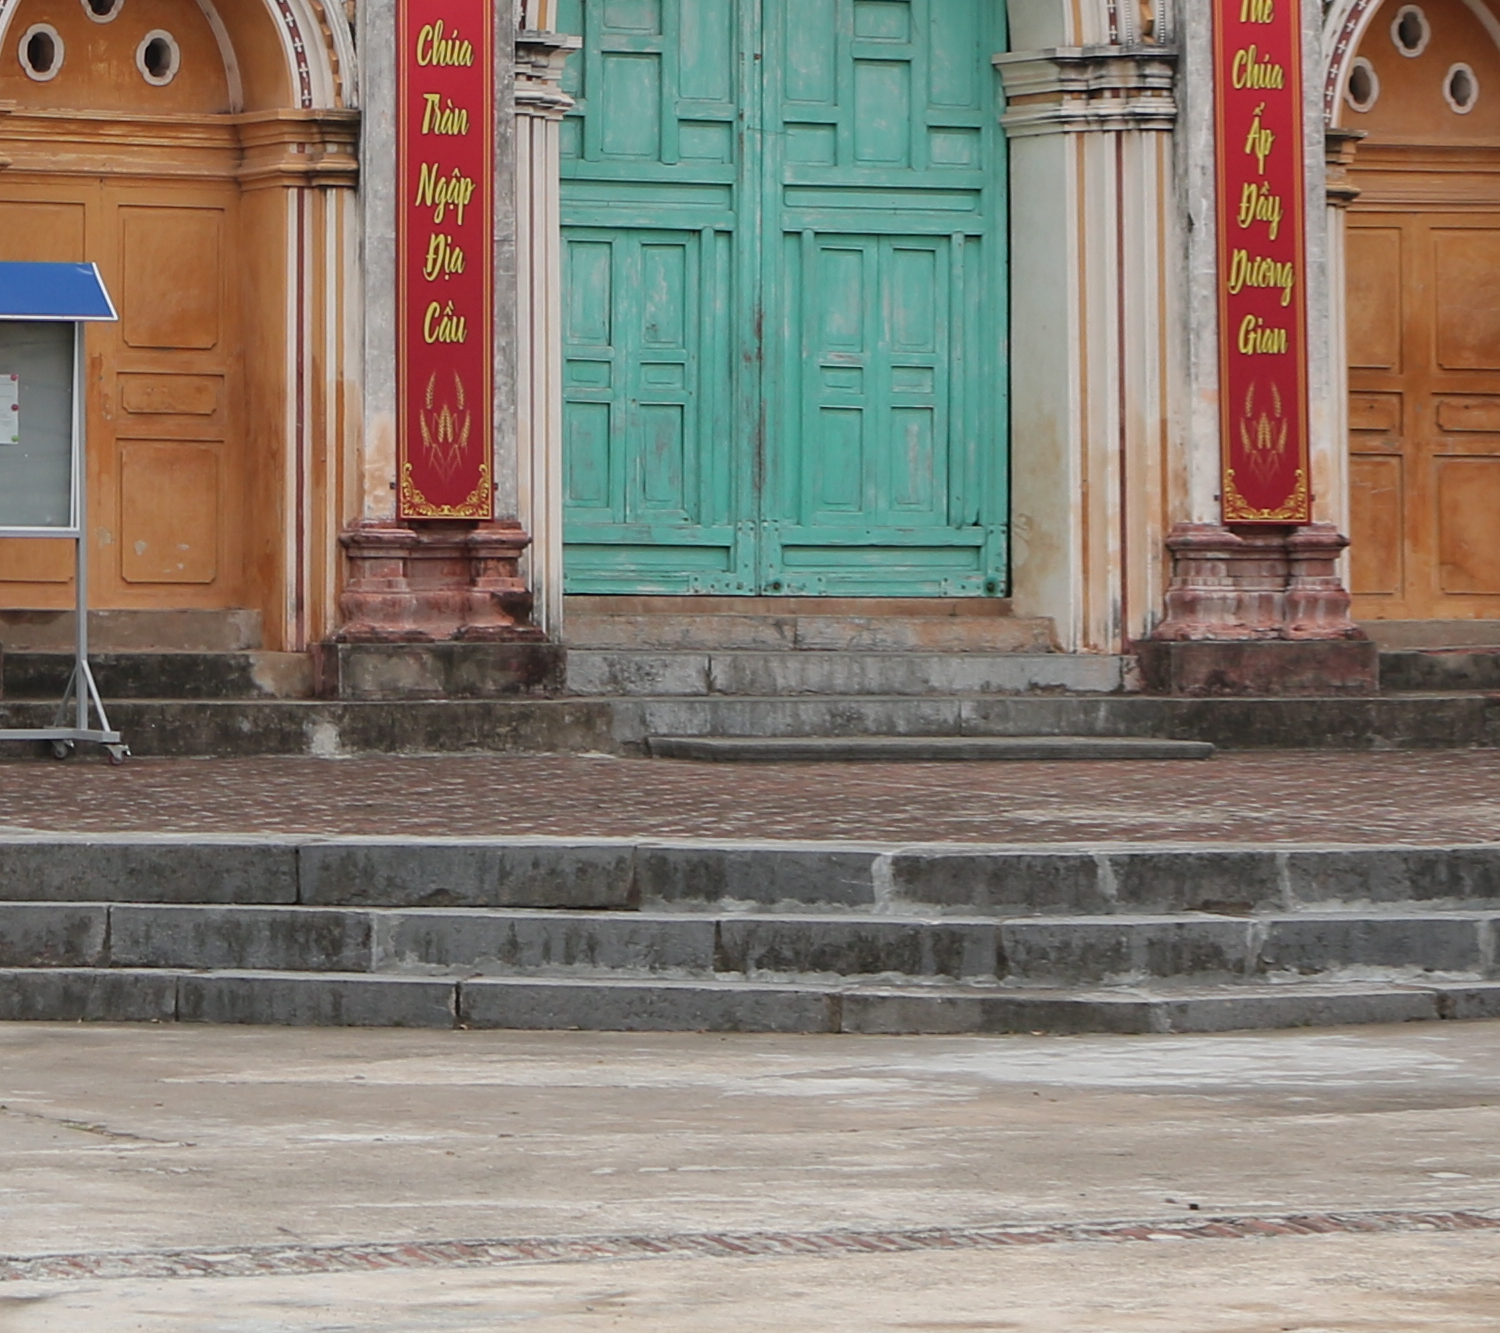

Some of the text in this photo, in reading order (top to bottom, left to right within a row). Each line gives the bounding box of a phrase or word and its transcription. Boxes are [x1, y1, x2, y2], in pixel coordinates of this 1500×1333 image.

[417, 19, 474, 66] Chúa
[1232, 44, 1284, 89] Chúa
[422, 93, 470, 136] Tràn
[1245, 101, 1276, 175] Ấp
[415, 162, 476, 226] Ngập
[1237, 181, 1284, 241] Đầy
[423, 233, 466, 281] Địa
[1228, 248, 1294, 307] Dương
[424, 300, 467, 344] Cầu
[1238, 314, 1289, 355] Gian
